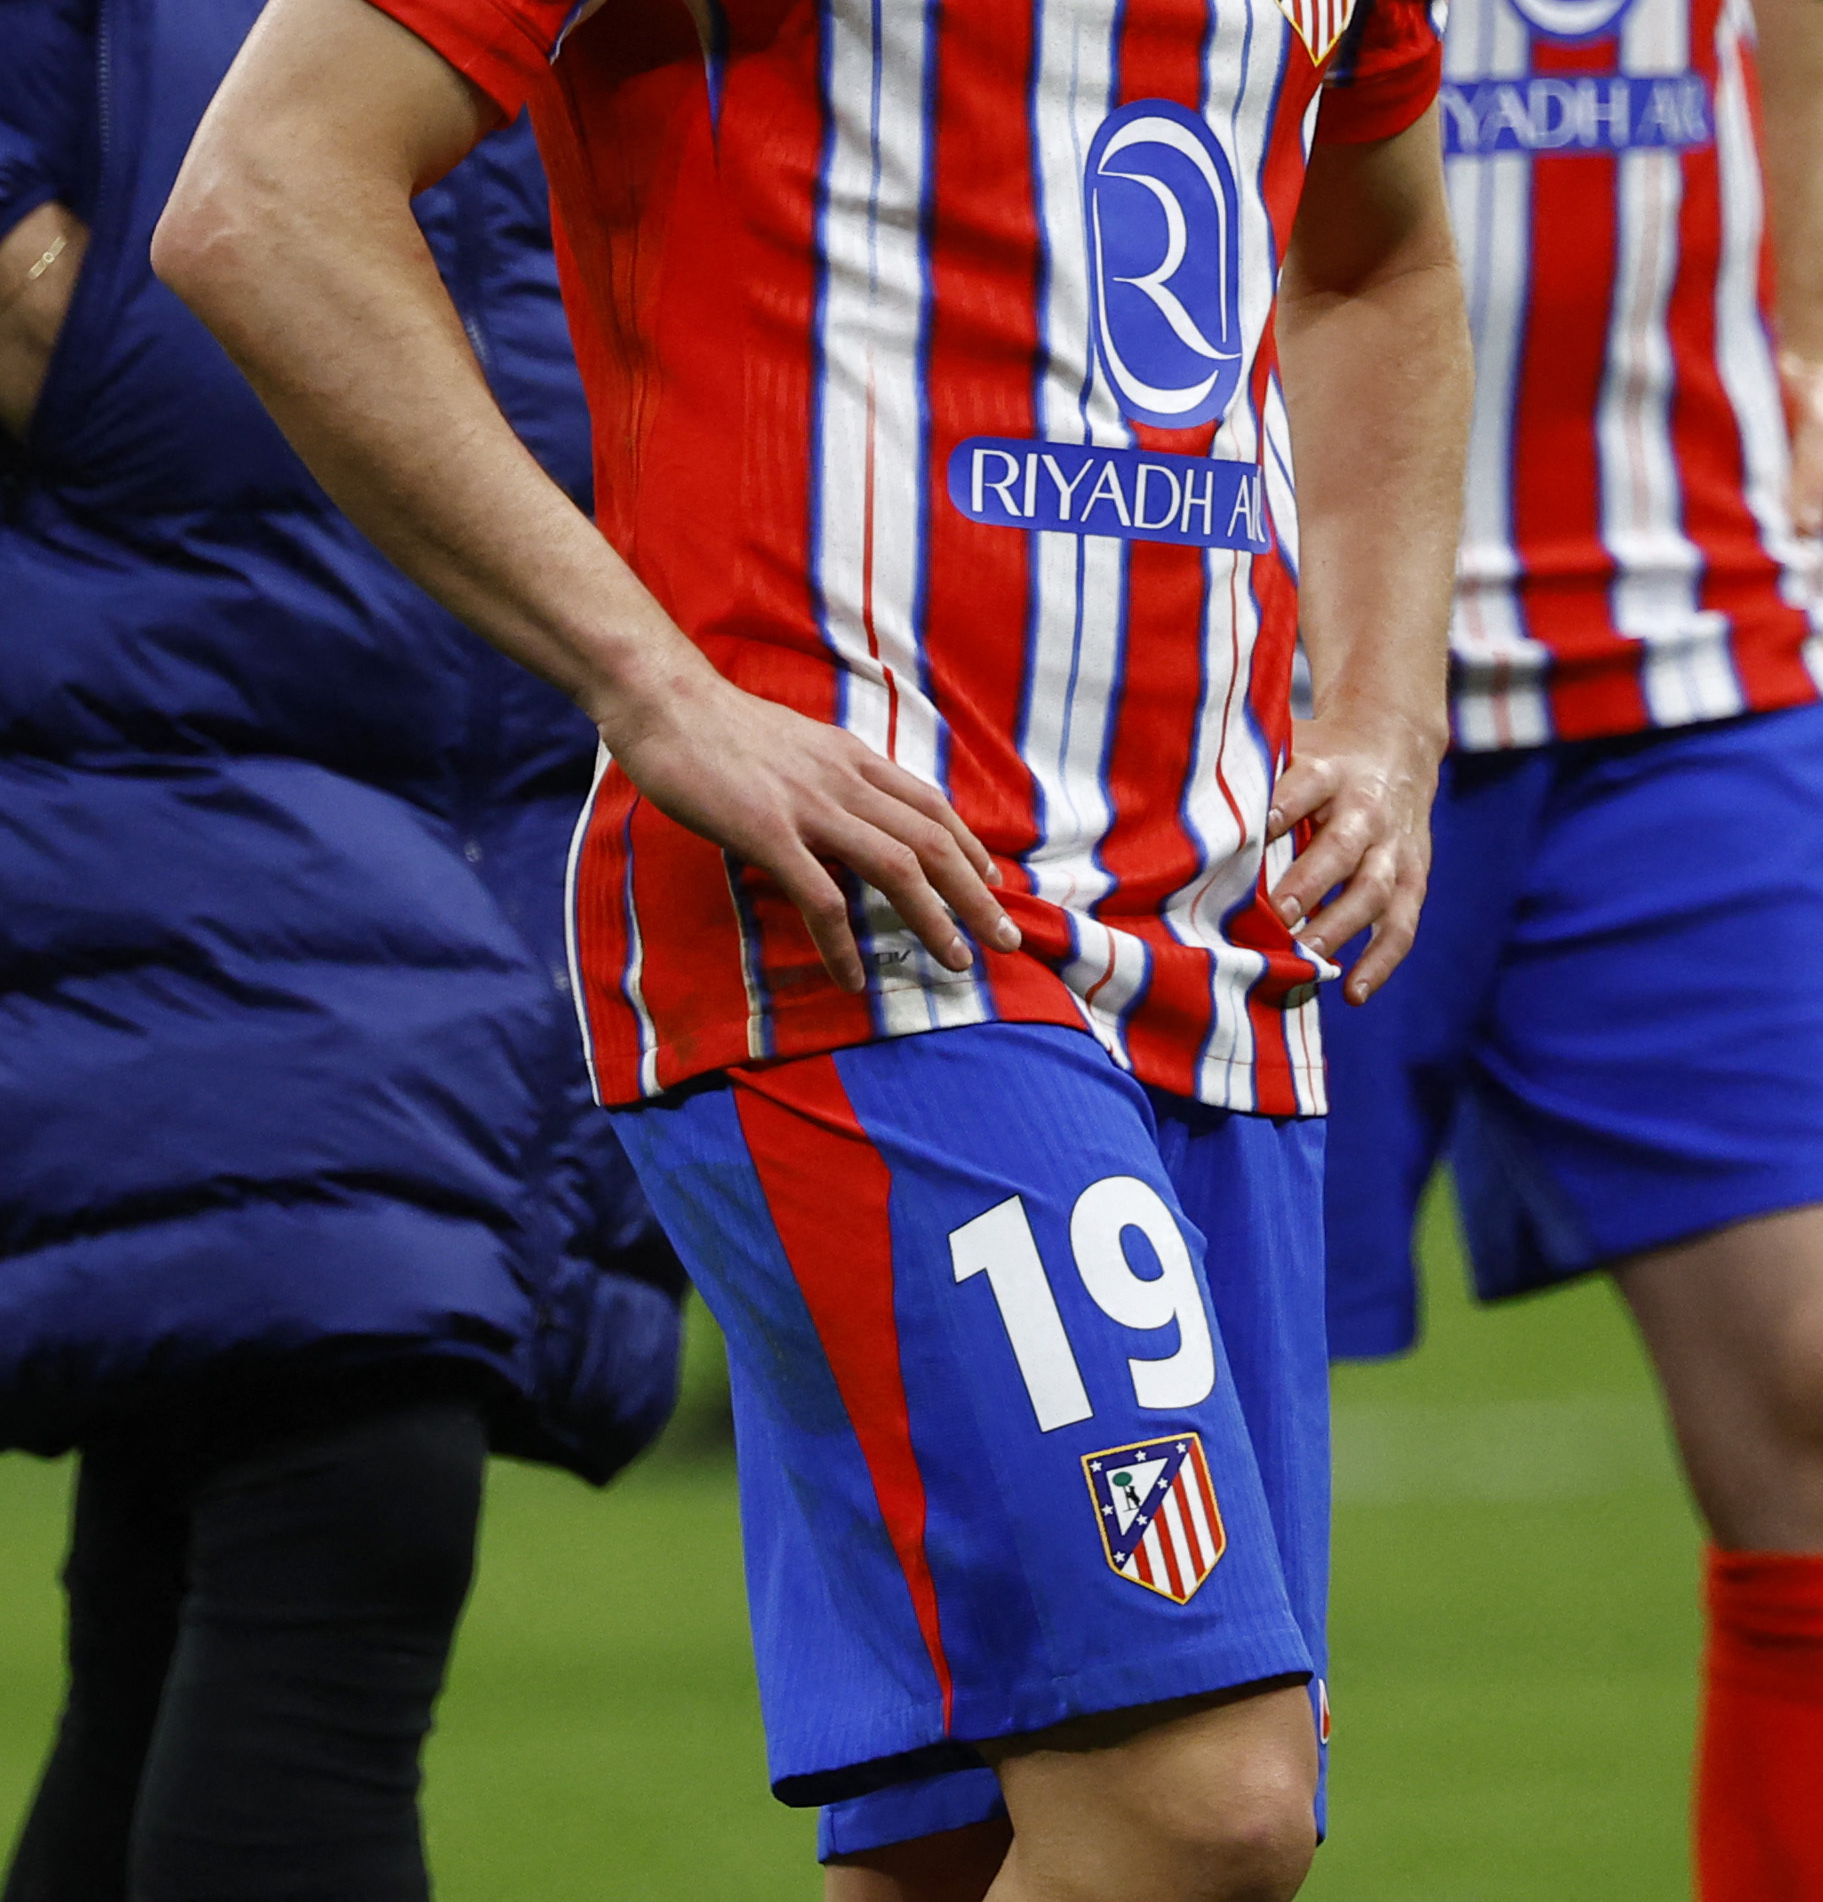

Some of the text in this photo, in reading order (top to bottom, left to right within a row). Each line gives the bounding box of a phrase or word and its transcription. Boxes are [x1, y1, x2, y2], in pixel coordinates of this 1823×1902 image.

[1439, 78, 1630, 148] YADH
[973, 447, 1214, 536] RIYADH
[948, 1175, 1215, 1432] 19
